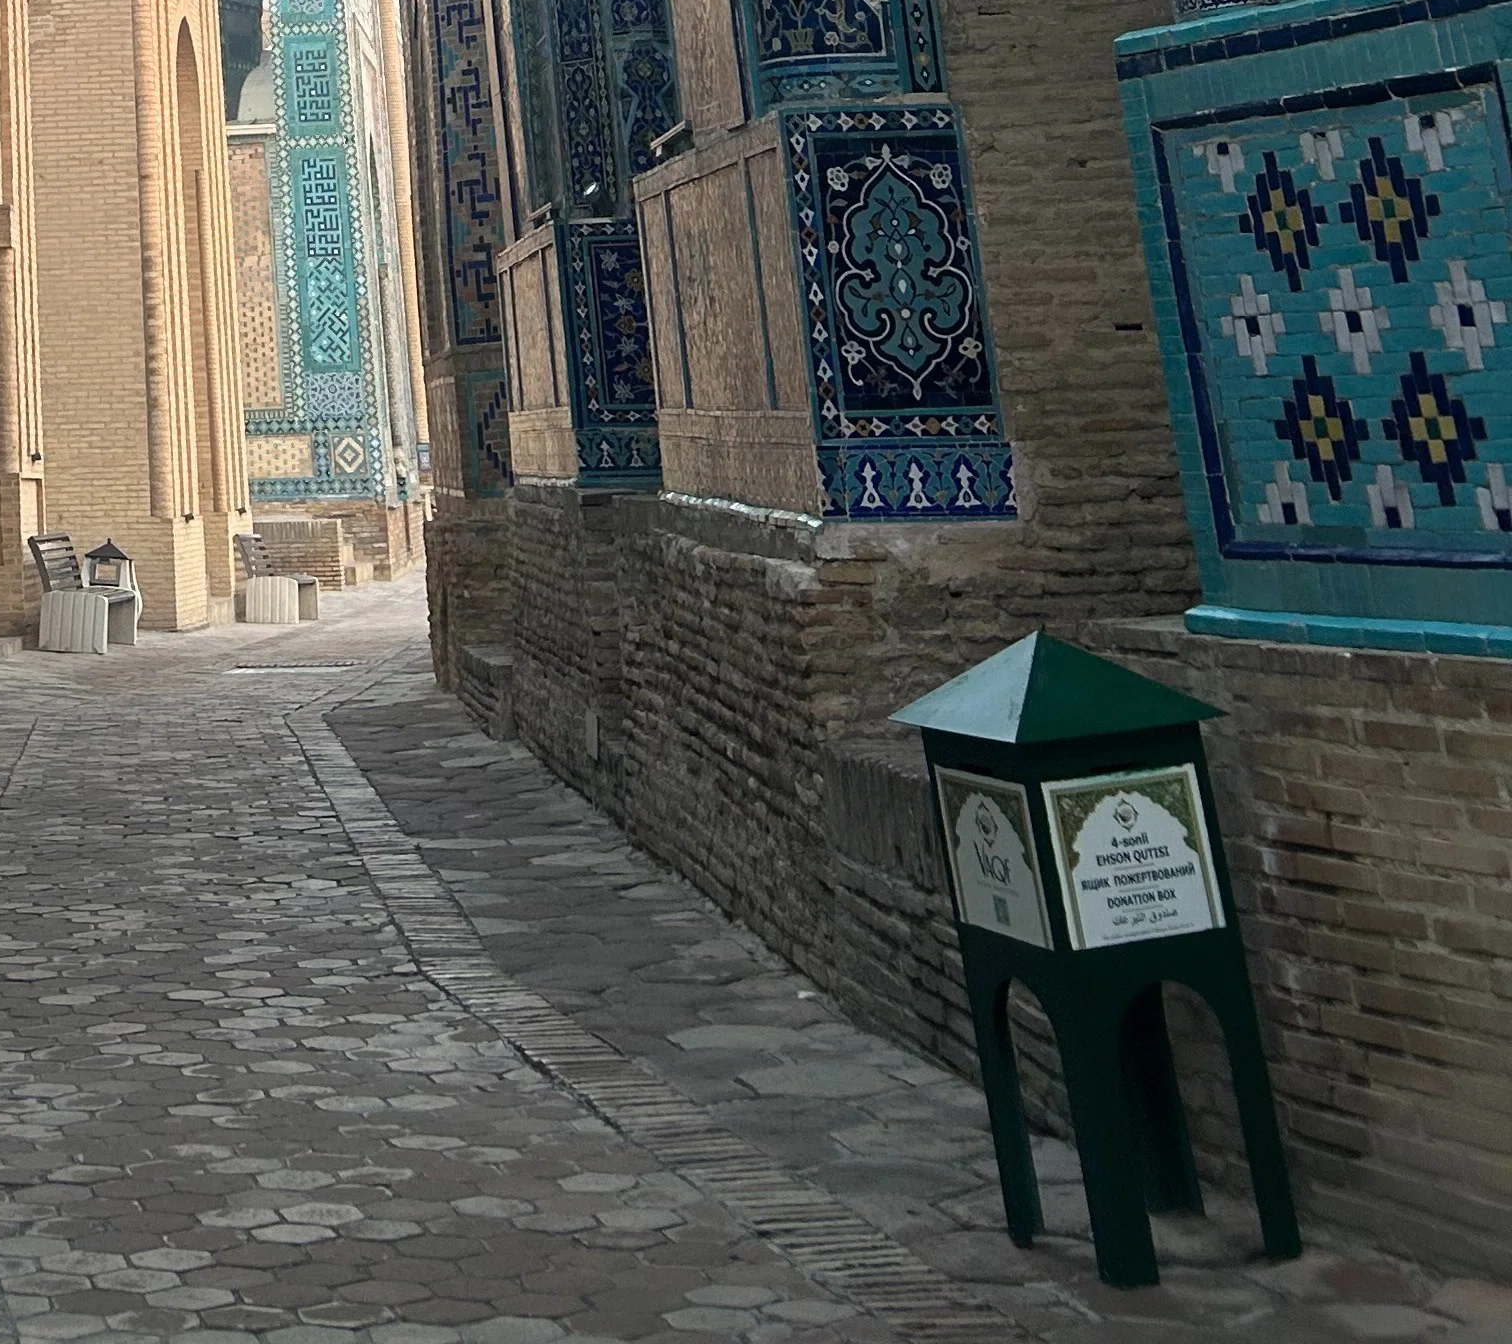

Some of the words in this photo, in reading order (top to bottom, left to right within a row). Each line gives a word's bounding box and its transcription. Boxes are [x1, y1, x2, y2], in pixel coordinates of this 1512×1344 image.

[1111, 832, 1149, 848] 4-sonli
[973, 840, 1011, 886] VAQF
[1096, 851, 1131, 867] EHSON
[1133, 846, 1170, 863] QUTISI
[1081, 877, 1111, 891] ЯЩИК
[1113, 861, 1196, 887] ПОЖЕРТВОВАНИЙ
[1107, 892, 1156, 909] DONATION
[1157, 889, 1177, 902] BOX
